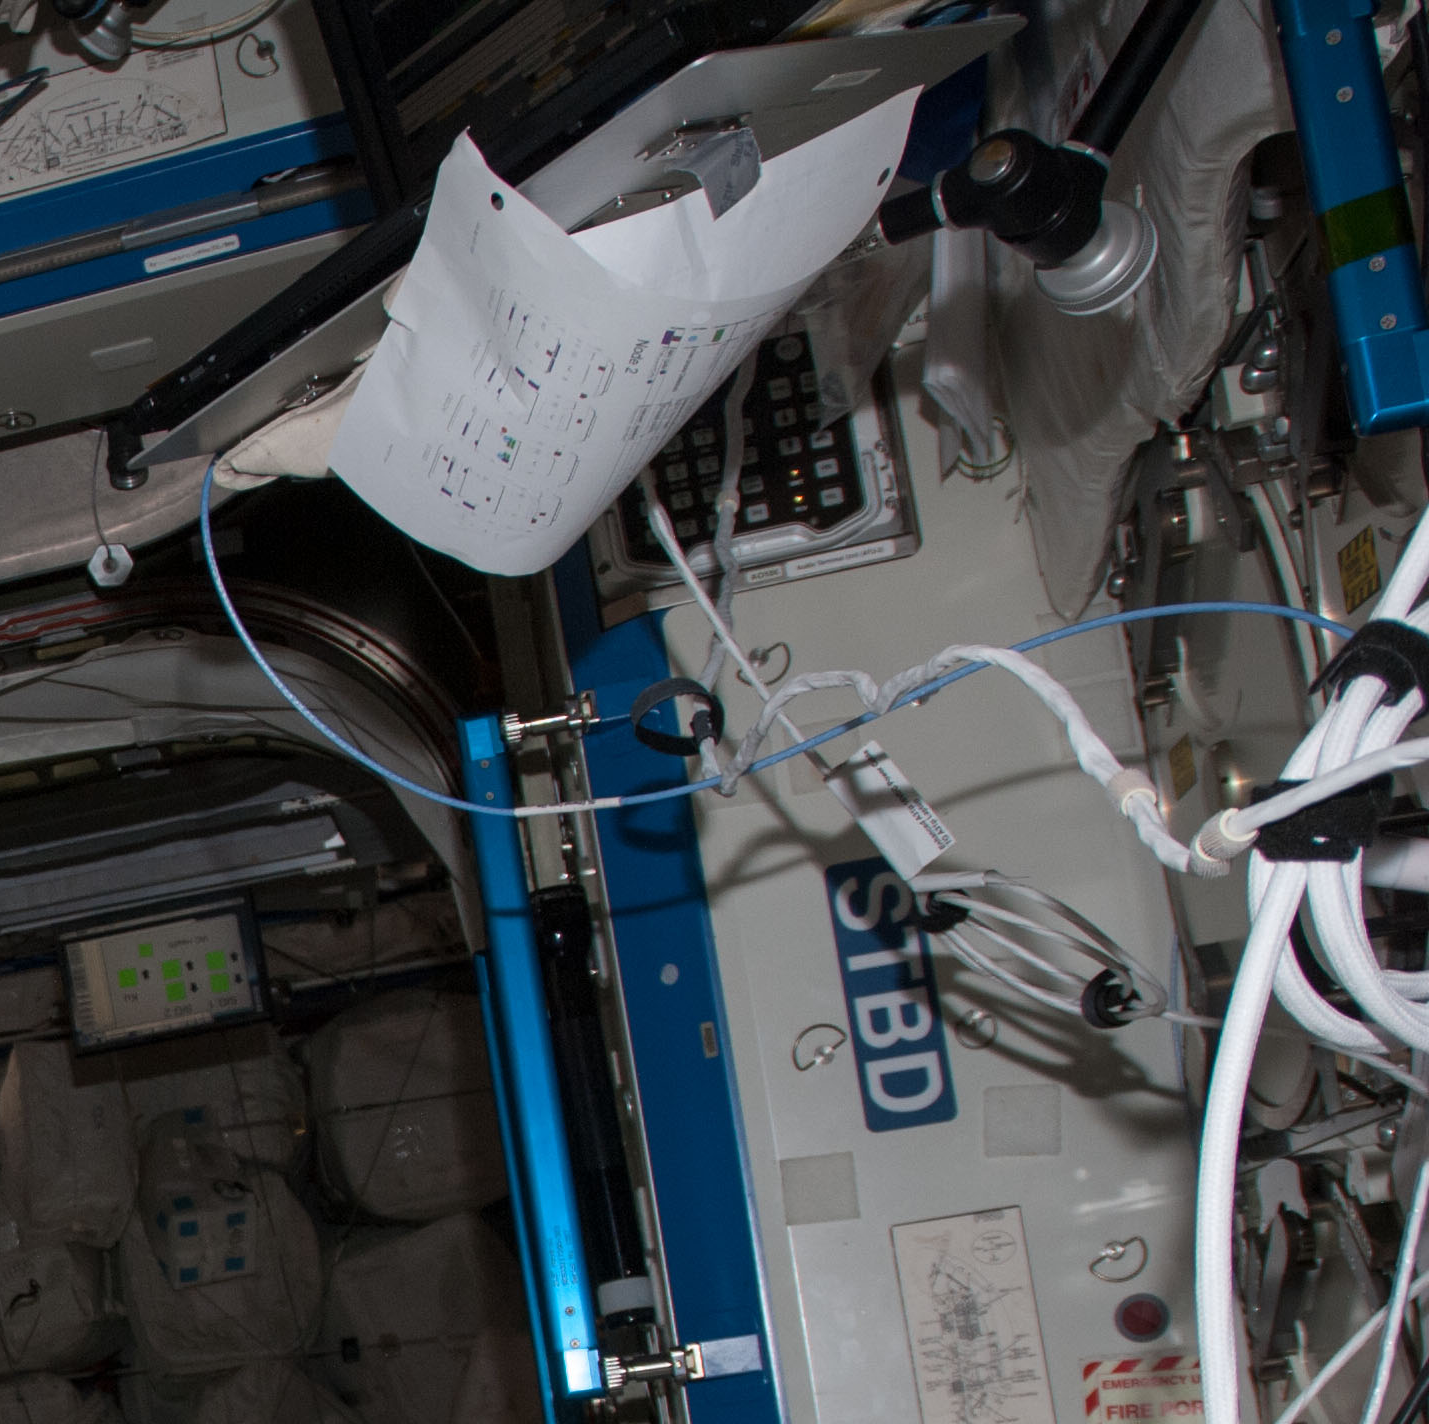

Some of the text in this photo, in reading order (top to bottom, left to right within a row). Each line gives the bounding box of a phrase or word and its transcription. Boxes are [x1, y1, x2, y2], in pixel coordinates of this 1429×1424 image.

[624, 338, 650, 375] Node 2
[796, 561, 816, 571] Audio
[817, 555, 845, 566] Terminal
[835, 870, 946, 1113] STBD
[1101, 1375, 1188, 1390] EMERGENCY
[1106, 1400, 1205, 1421] FIRE POR
